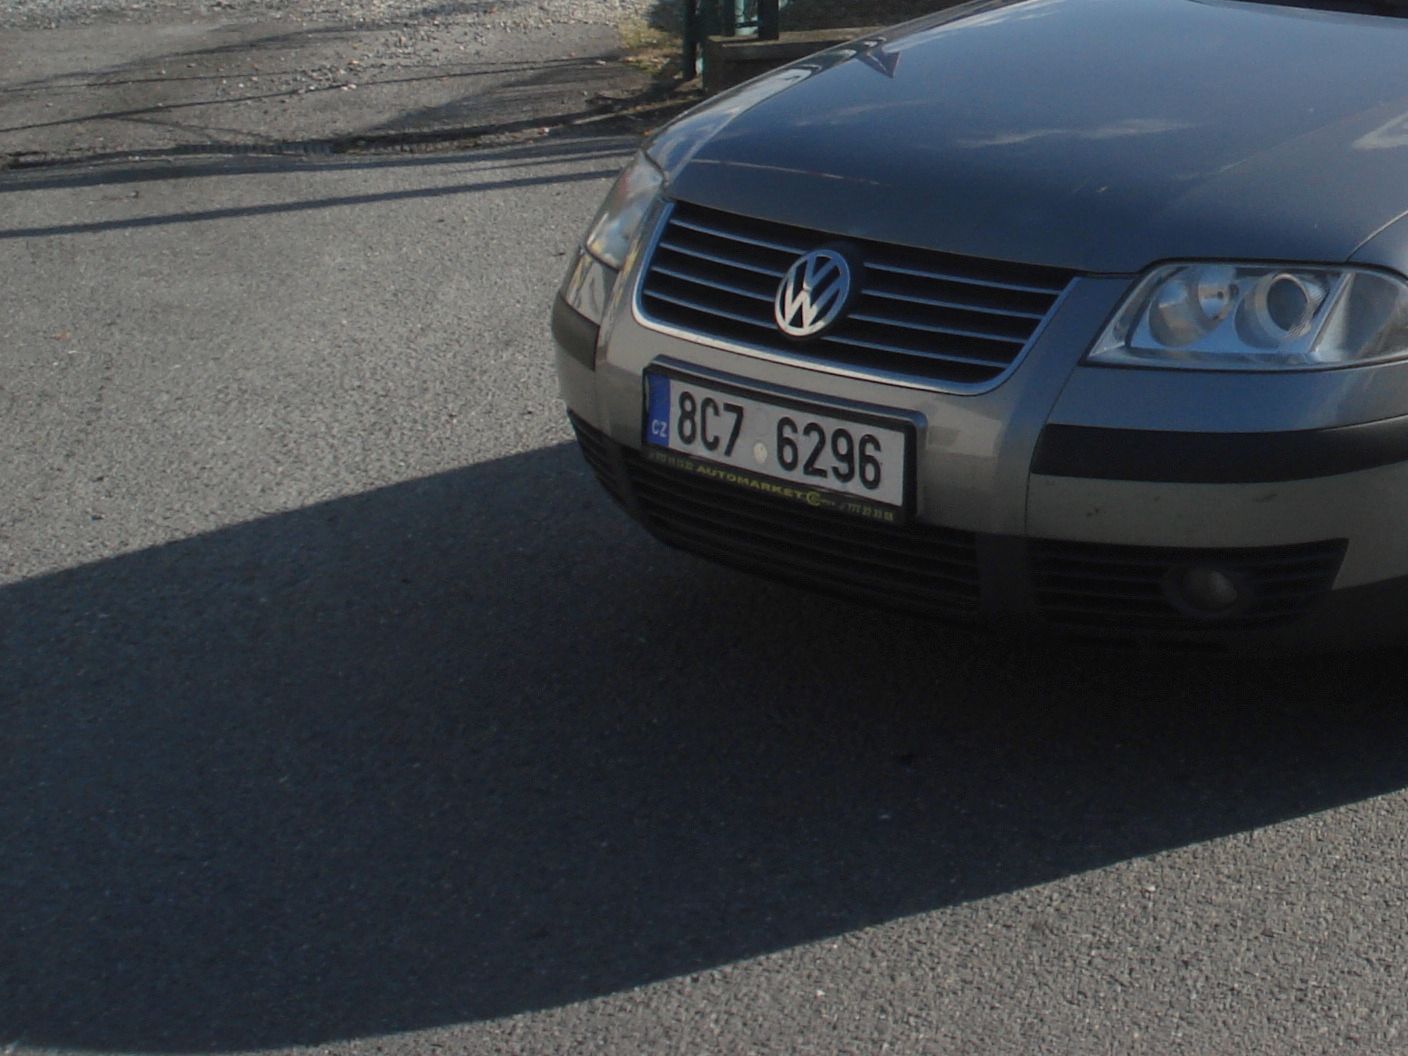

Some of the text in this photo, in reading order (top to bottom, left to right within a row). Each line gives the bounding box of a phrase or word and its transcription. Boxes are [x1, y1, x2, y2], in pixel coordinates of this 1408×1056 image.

[651, 418, 668, 438] CZ
[677, 390, 882, 491] 8C7 6296
[695, 464, 803, 500] AUTOMARKET
